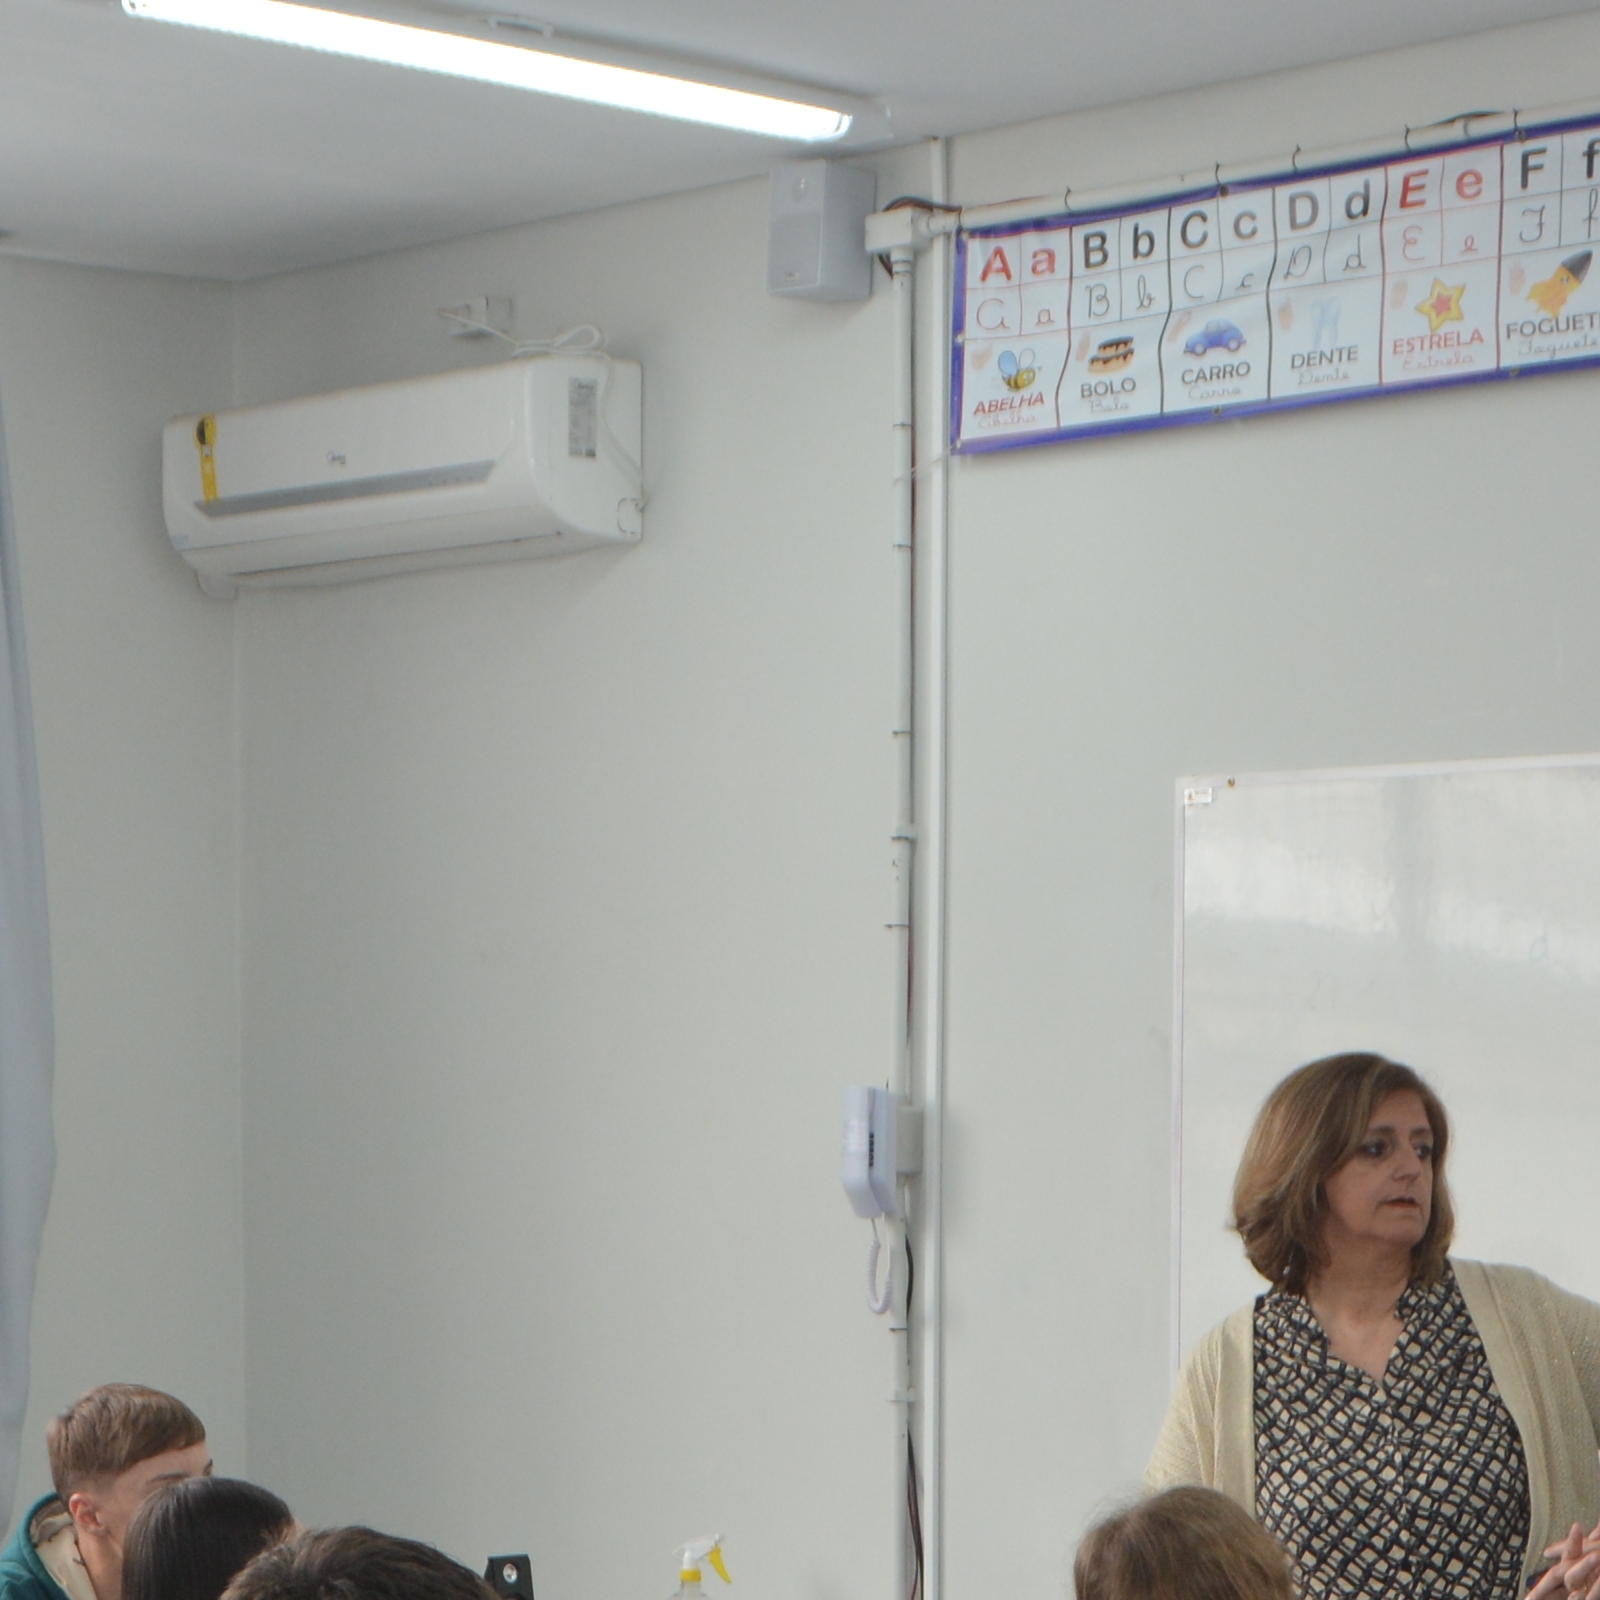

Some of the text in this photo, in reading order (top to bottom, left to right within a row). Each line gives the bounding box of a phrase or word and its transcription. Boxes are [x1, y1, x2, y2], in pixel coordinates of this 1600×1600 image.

[1520, 146, 1548, 189] F
[1288, 179, 1369, 228] D d
[1400, 167, 1483, 208] E e
[1082, 226, 1155, 269] B b
[1181, 211, 1257, 249] C c
[979, 245, 1056, 282] A a
[1290, 345, 1358, 369] DENTE
[1392, 328, 1484, 355] ESTRELA
[1080, 377, 1137, 399] BOLO
[1181, 361, 1251, 385] CARRO
[972, 391, 1045, 416] ABELHA
